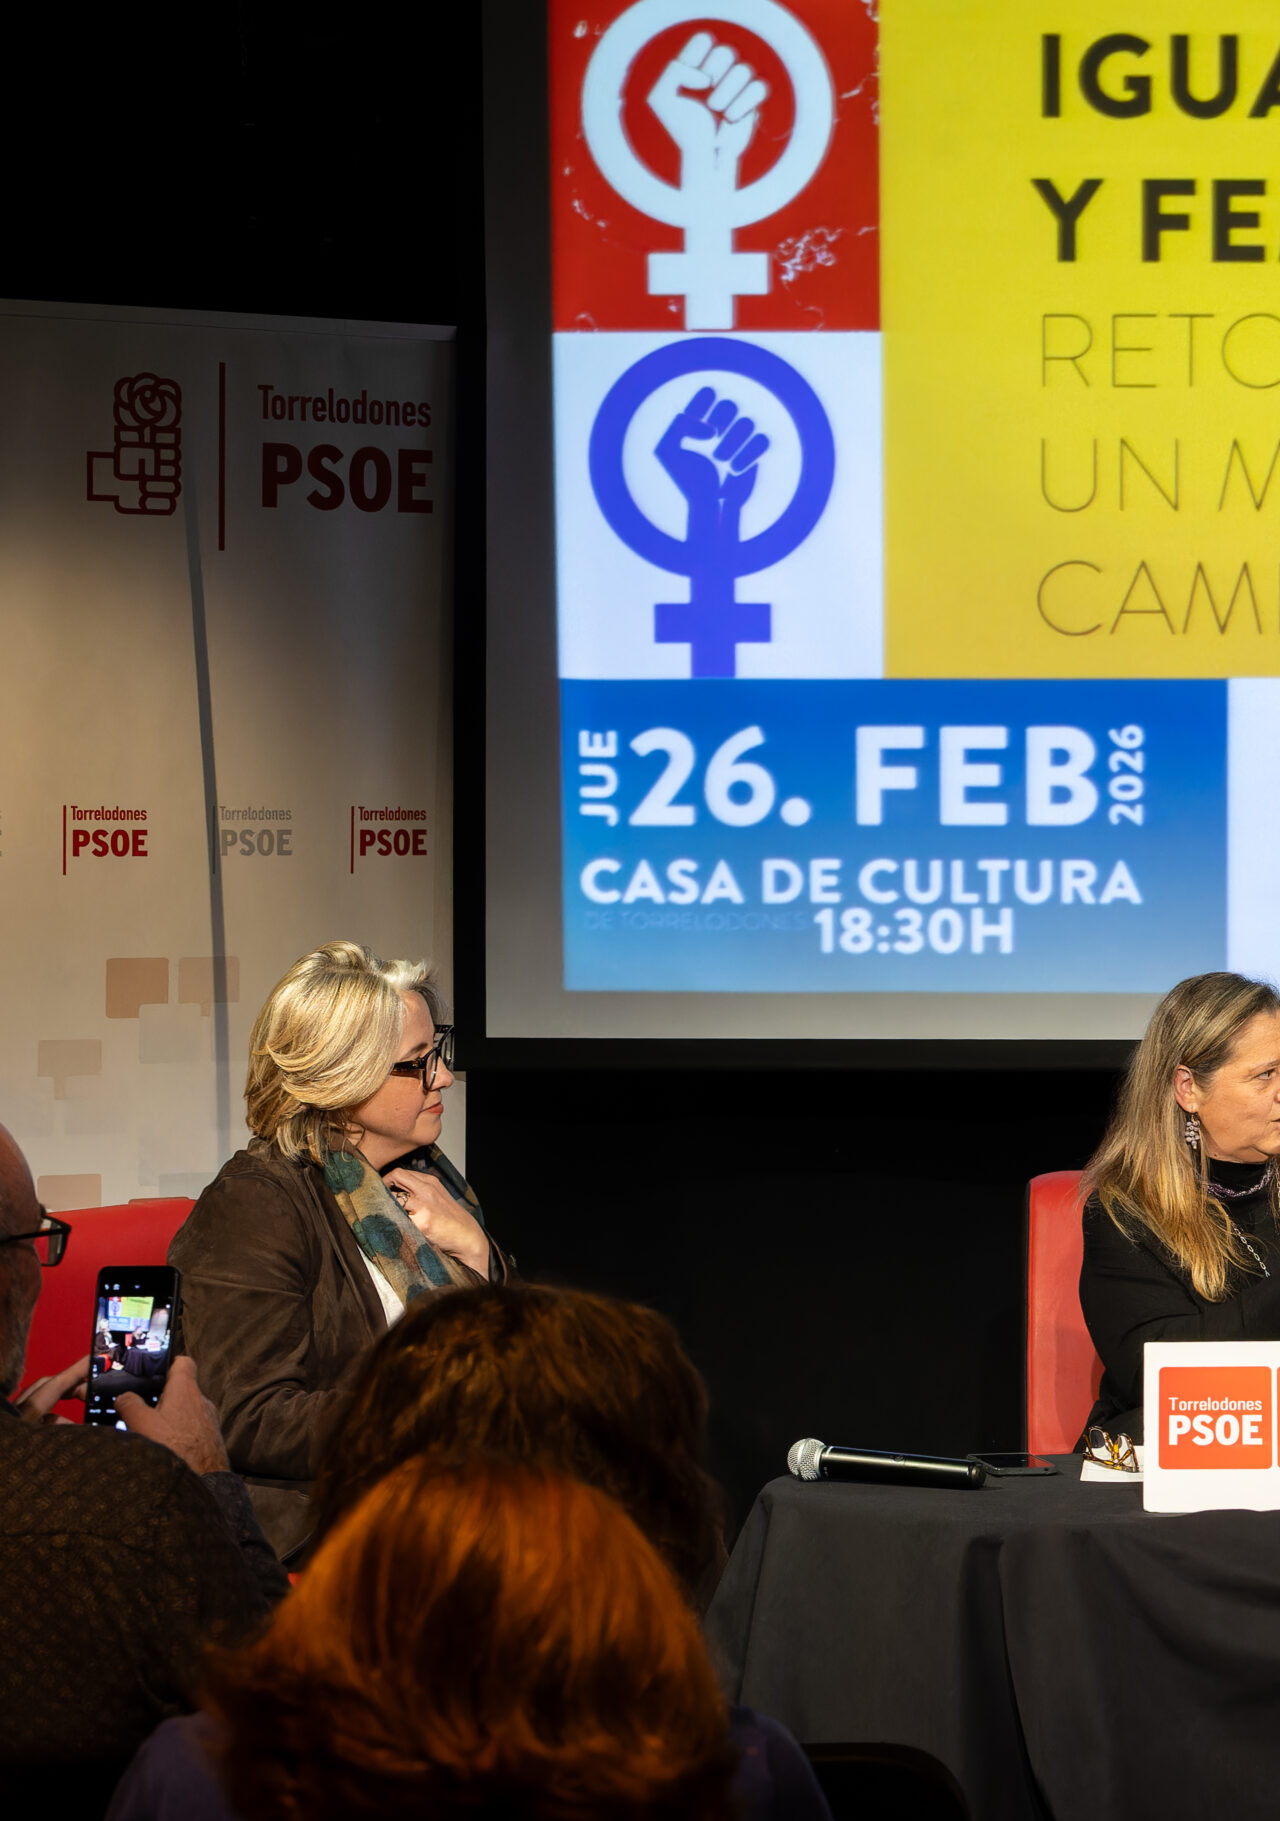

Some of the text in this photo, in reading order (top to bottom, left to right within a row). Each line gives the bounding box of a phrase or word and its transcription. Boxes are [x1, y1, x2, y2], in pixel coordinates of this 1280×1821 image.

[1031, 177, 1105, 263] Y
[258, 384, 431, 428] Torrelodones
[261, 442, 434, 514] PSOE
[1041, 438, 1180, 514] UN
[578, 729, 618, 827] JUE
[628, 725, 1100, 827] 26. FEB
[1107, 724, 1145, 826] 2026
[70, 805, 148, 822] Torrelodones
[219, 806, 293, 822] Torrelodones
[358, 806, 427, 822] Torrelodones
[72, 829, 148, 858] PSOE
[220, 829, 293, 857] PSOE
[359, 829, 428, 857] PSOE
[580, 859, 1143, 905] CASA DE CULTURA
[812, 907, 1014, 955] 18:30H
[1168, 1396, 1263, 1411] Torrelodones
[1168, 1414, 1263, 1446] PSOE
